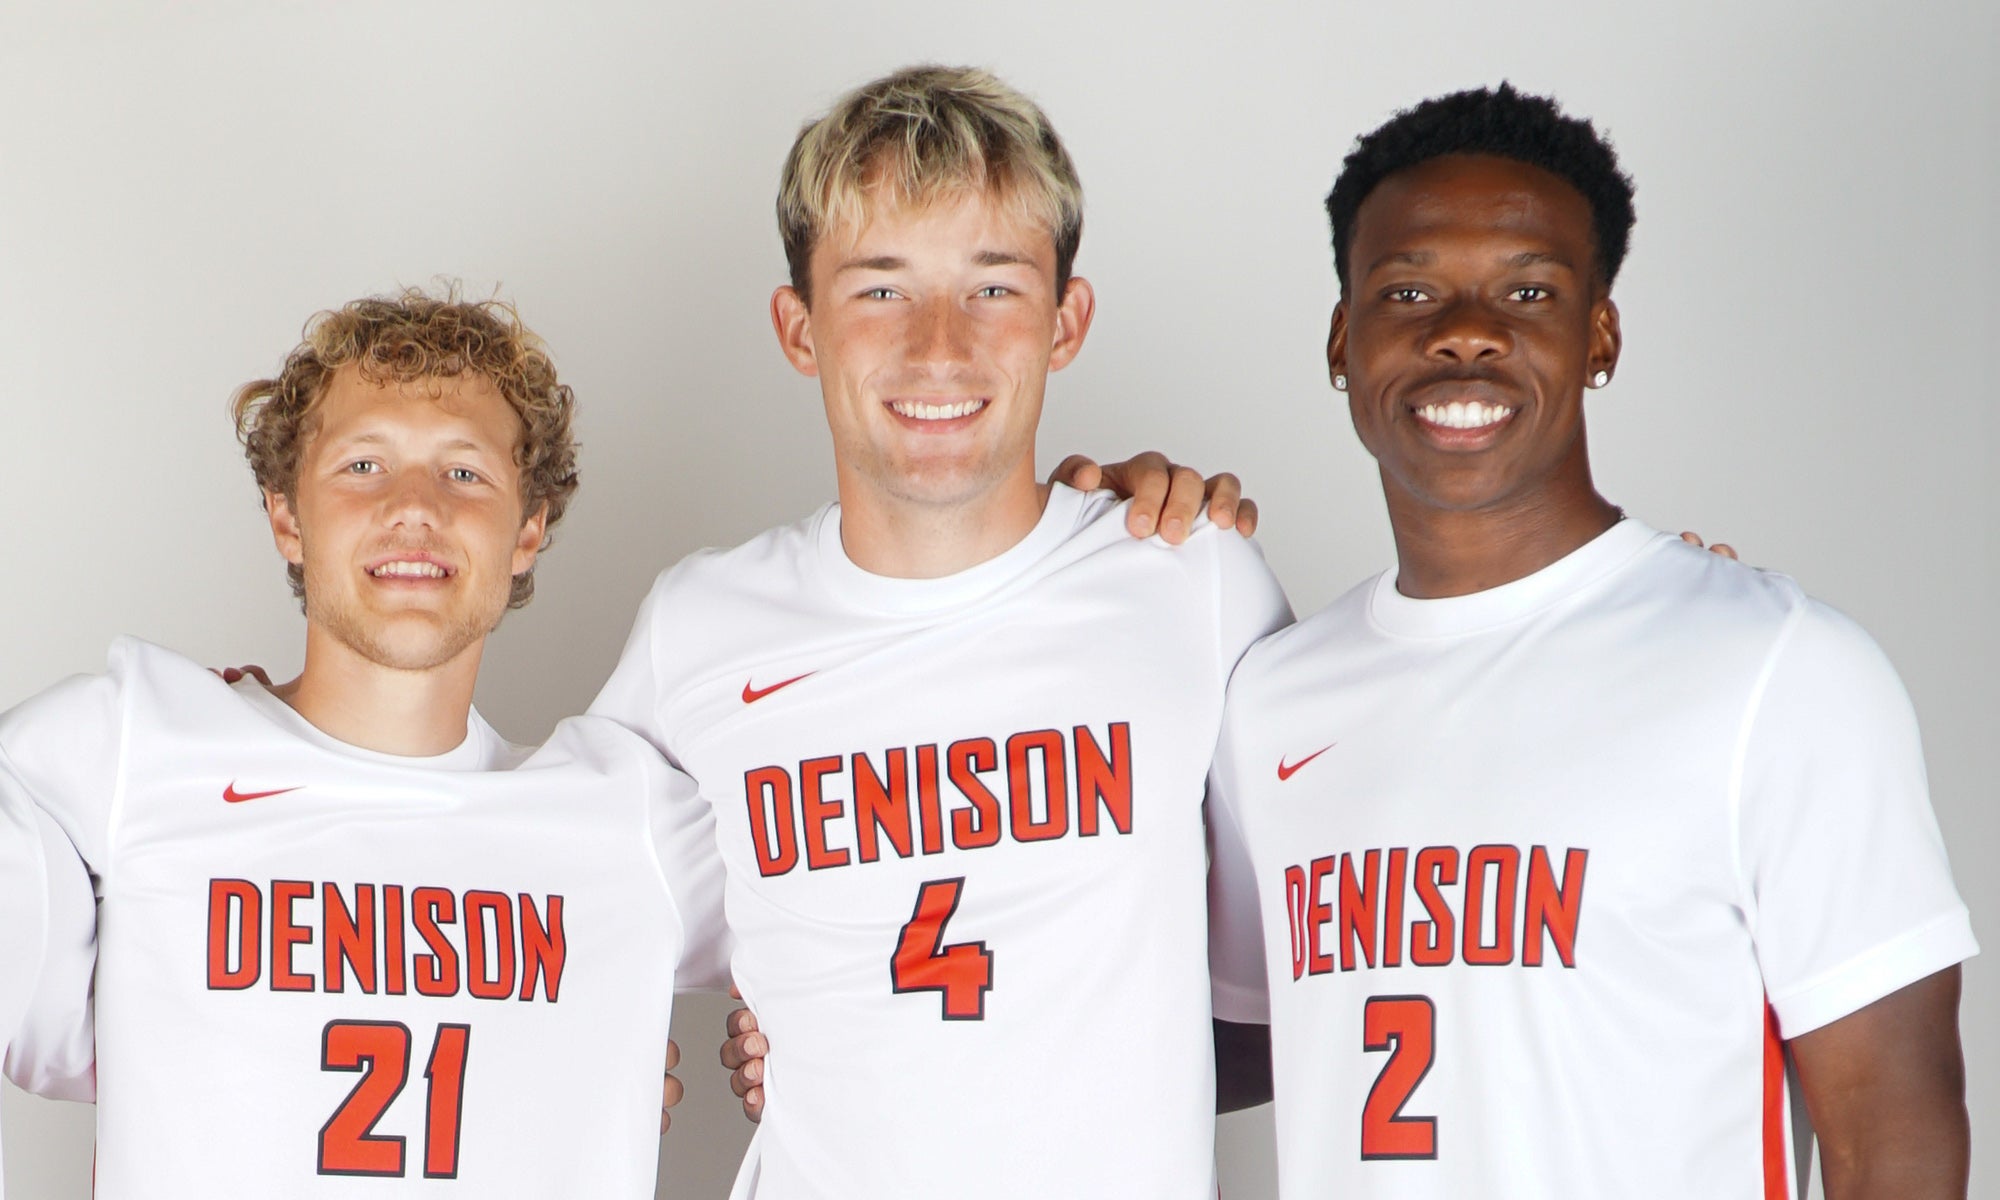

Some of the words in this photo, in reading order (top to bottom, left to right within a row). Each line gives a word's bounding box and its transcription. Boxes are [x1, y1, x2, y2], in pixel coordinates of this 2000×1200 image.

[744, 721, 1133, 877] DENISON
[206, 877, 566, 1004] DENISON
[890, 877, 994, 1022] 4
[1284, 843, 1589, 982] DENISON
[316, 1018, 472, 1180] 21
[1361, 994, 1438, 1162] 2
